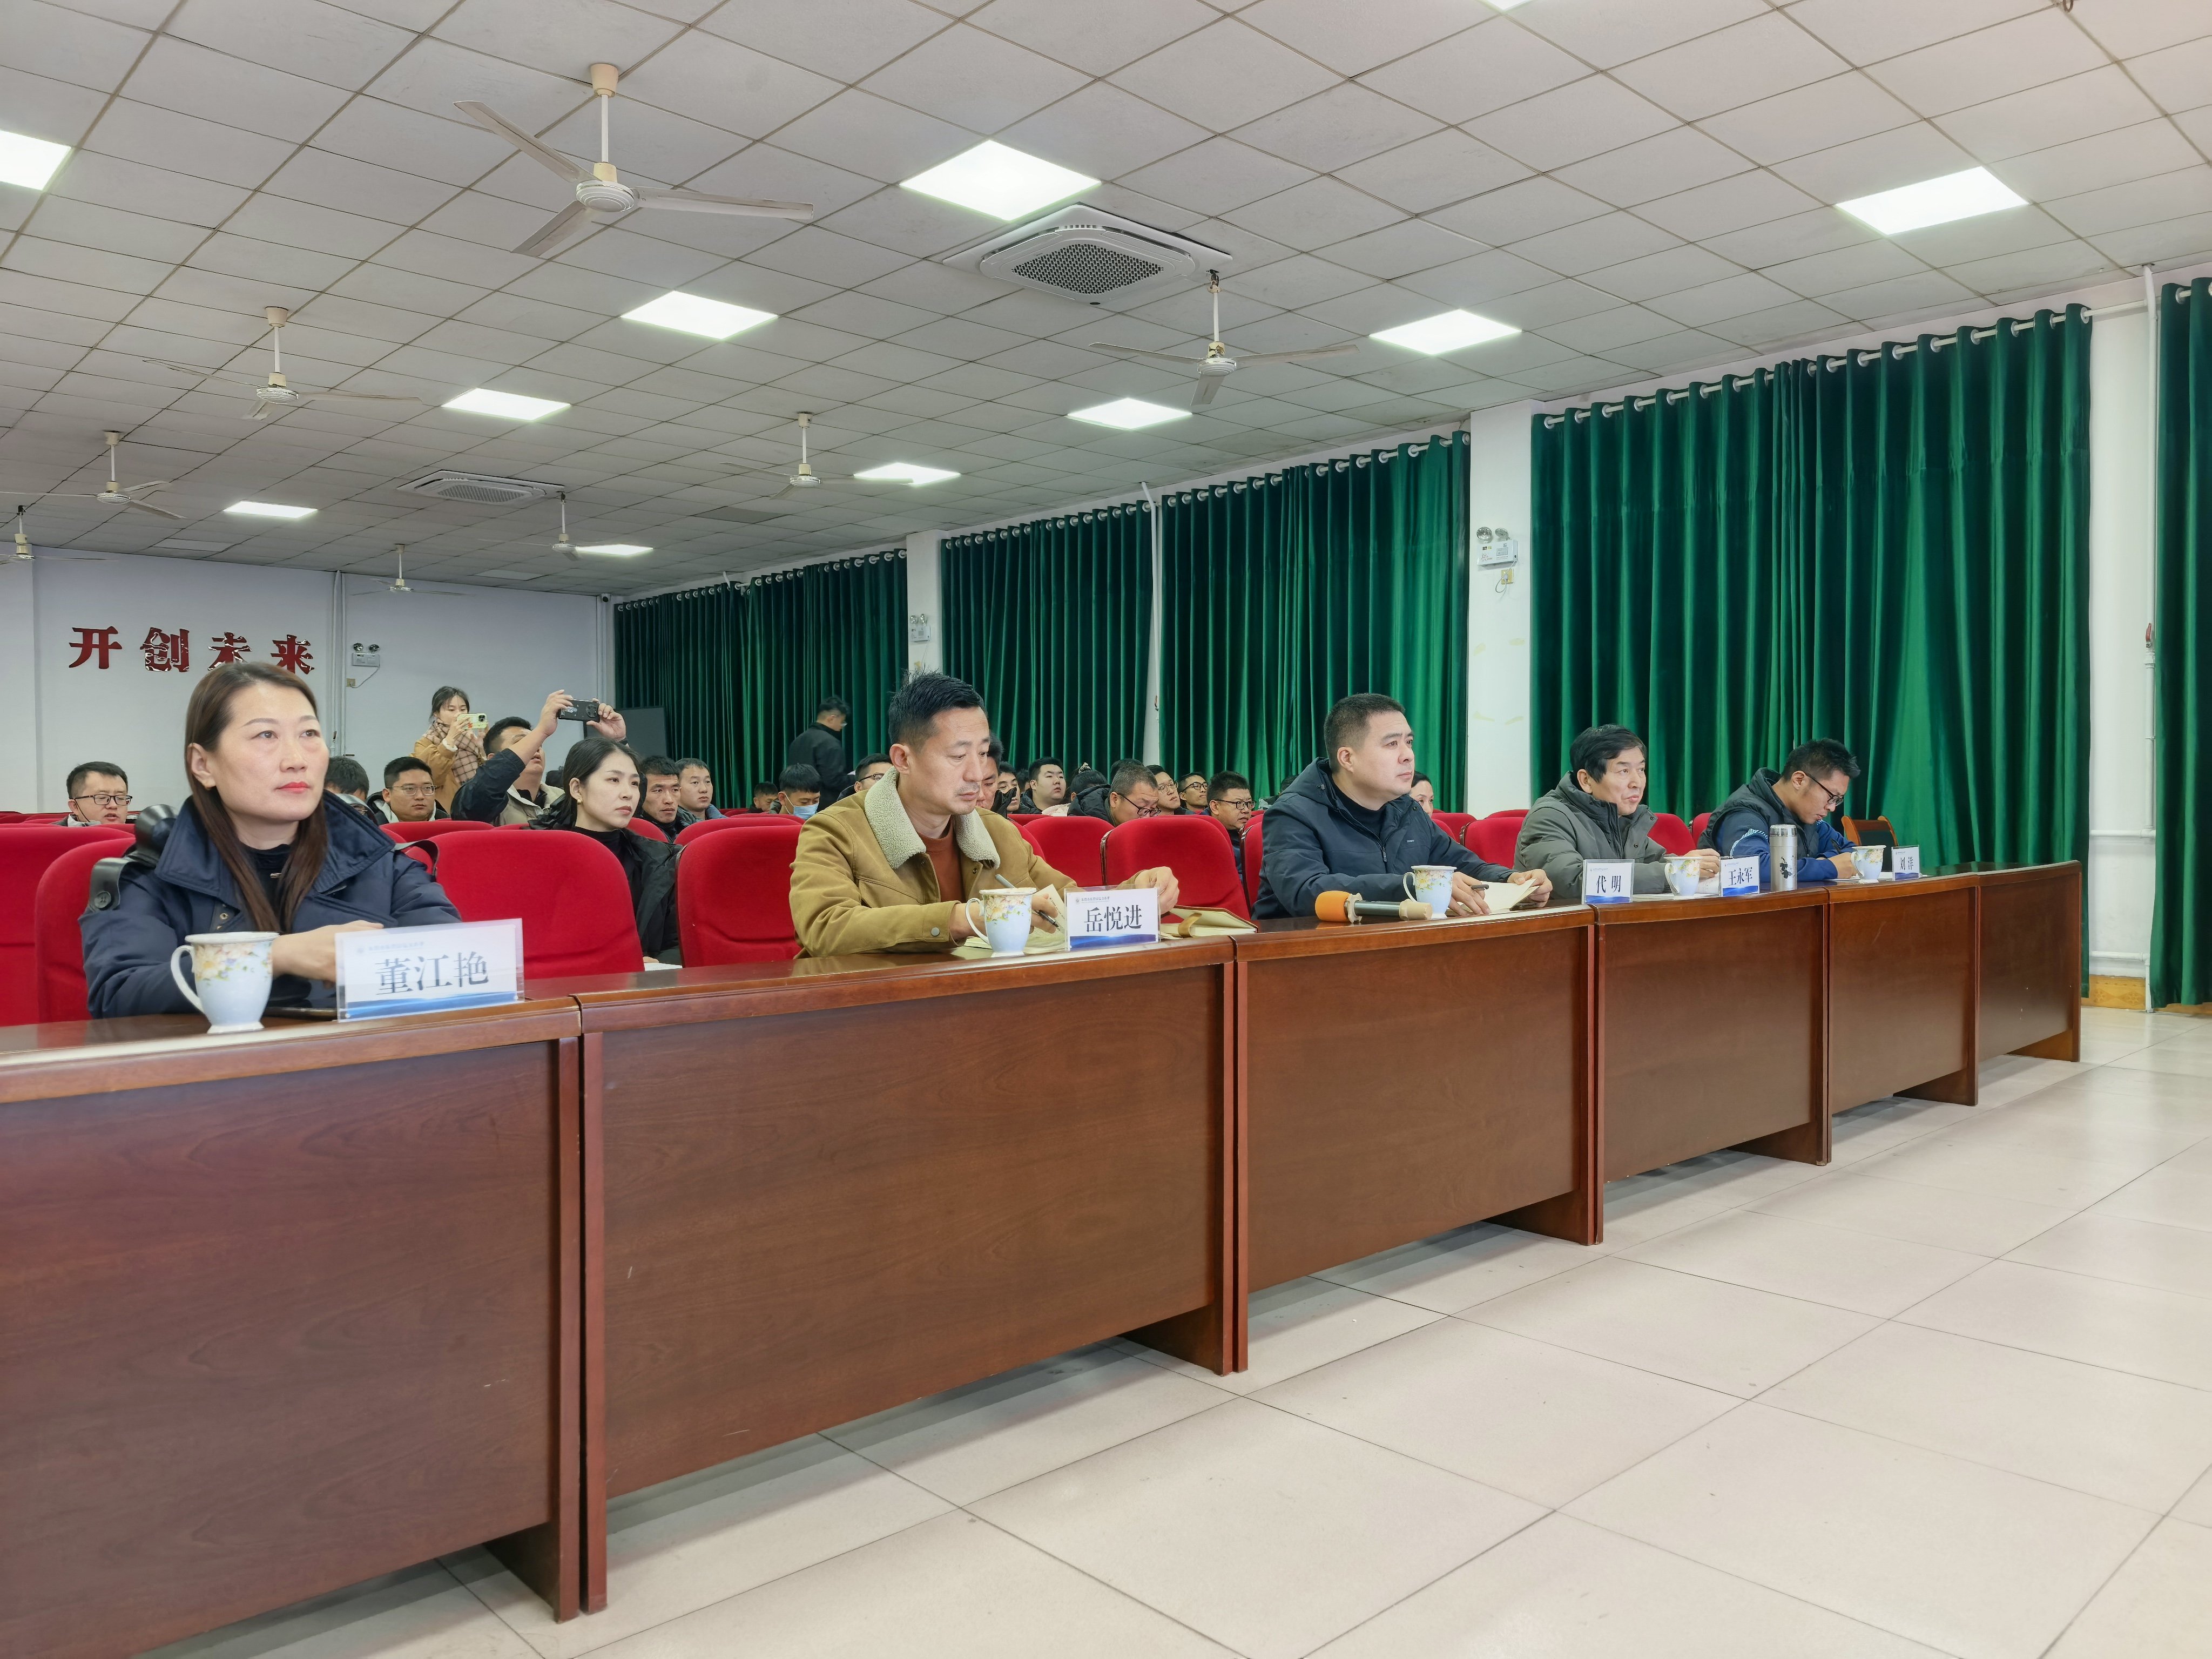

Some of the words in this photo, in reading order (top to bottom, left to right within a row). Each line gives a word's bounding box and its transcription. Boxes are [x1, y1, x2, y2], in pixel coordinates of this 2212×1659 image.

[69, 626, 315, 675] 开创未来
[1596, 875, 1621, 893] 代明
[1728, 867, 1752, 886] 王永军
[1084, 905, 1142, 933] 岳悦进
[375, 951, 489, 995] 董江艳
